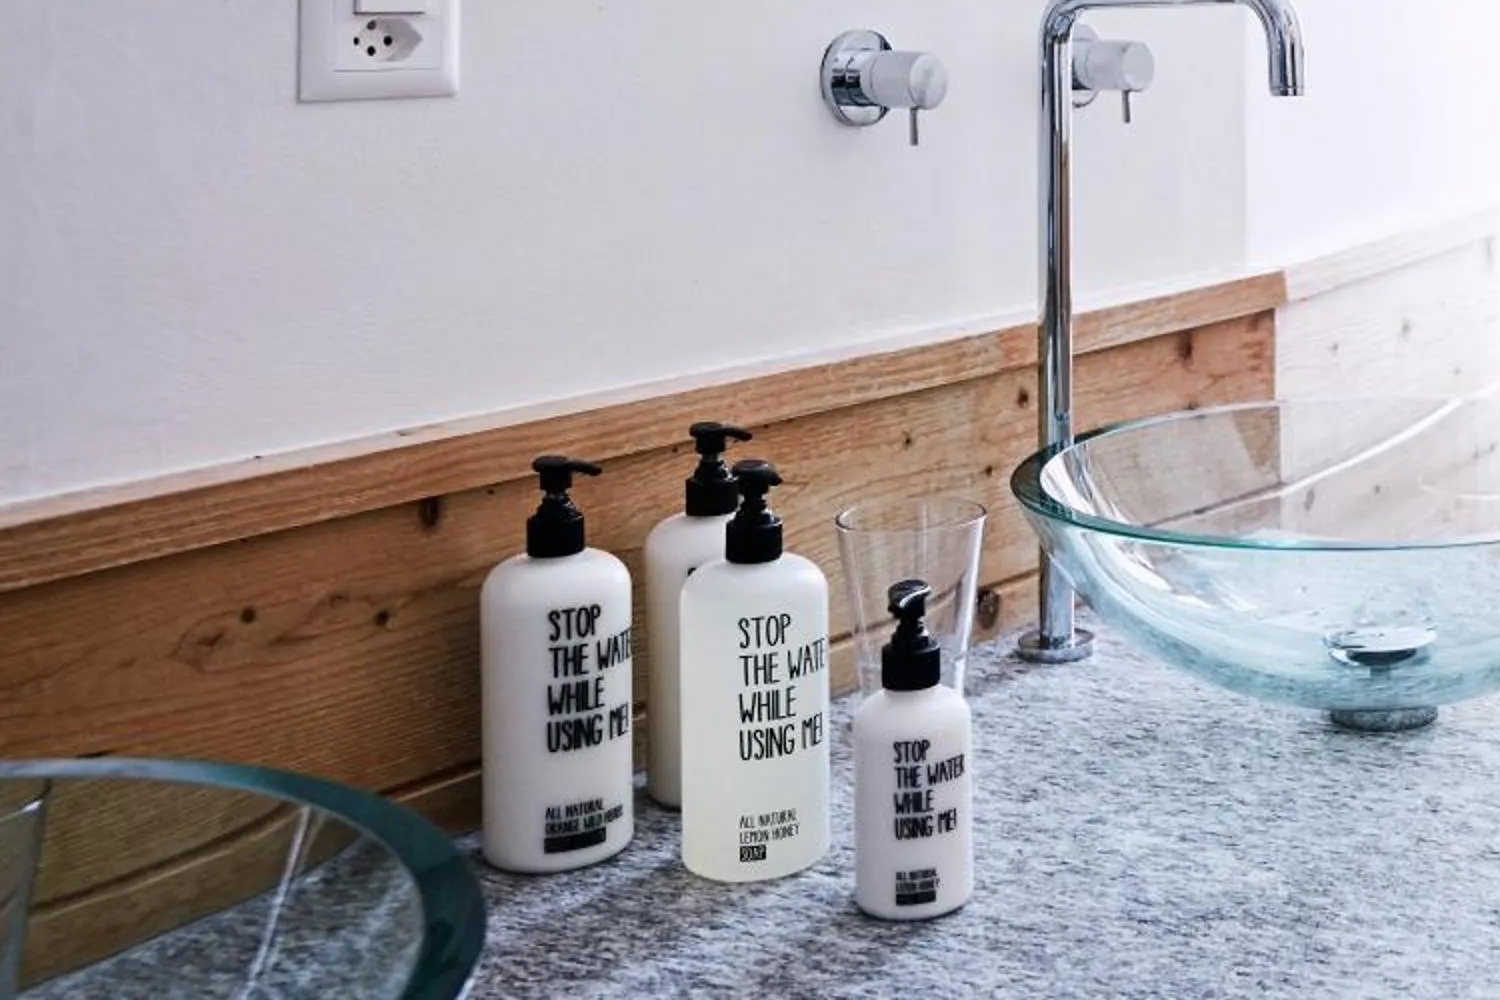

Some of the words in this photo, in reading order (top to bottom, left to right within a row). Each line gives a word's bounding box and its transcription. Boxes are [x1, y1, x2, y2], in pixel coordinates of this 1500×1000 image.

[547, 603, 602, 641] STOP
[737, 613, 791, 649] STOP
[548, 643, 590, 678] THE
[597, 627, 632, 670] WATE
[738, 651, 780, 686] THE
[787, 637, 826, 680] WATE
[547, 677, 605, 716] WHILE
[738, 685, 796, 723] WHILE
[546, 714, 603, 752] USING
[609, 704, 629, 741] ME!
[739, 723, 795, 761] USING
[801, 712, 823, 750] ME!
[893, 739, 930, 763] STOP
[894, 766, 921, 789] THE
[927, 754, 965, 785] WATER
[740, 815, 755, 828] ALL
[758, 807, 797, 826] NATURAL
[893, 789, 934, 814] WHILE
[740, 829, 769, 845] LEMON
[894, 816, 933, 840] USING
[937, 808, 957, 834] ME!
